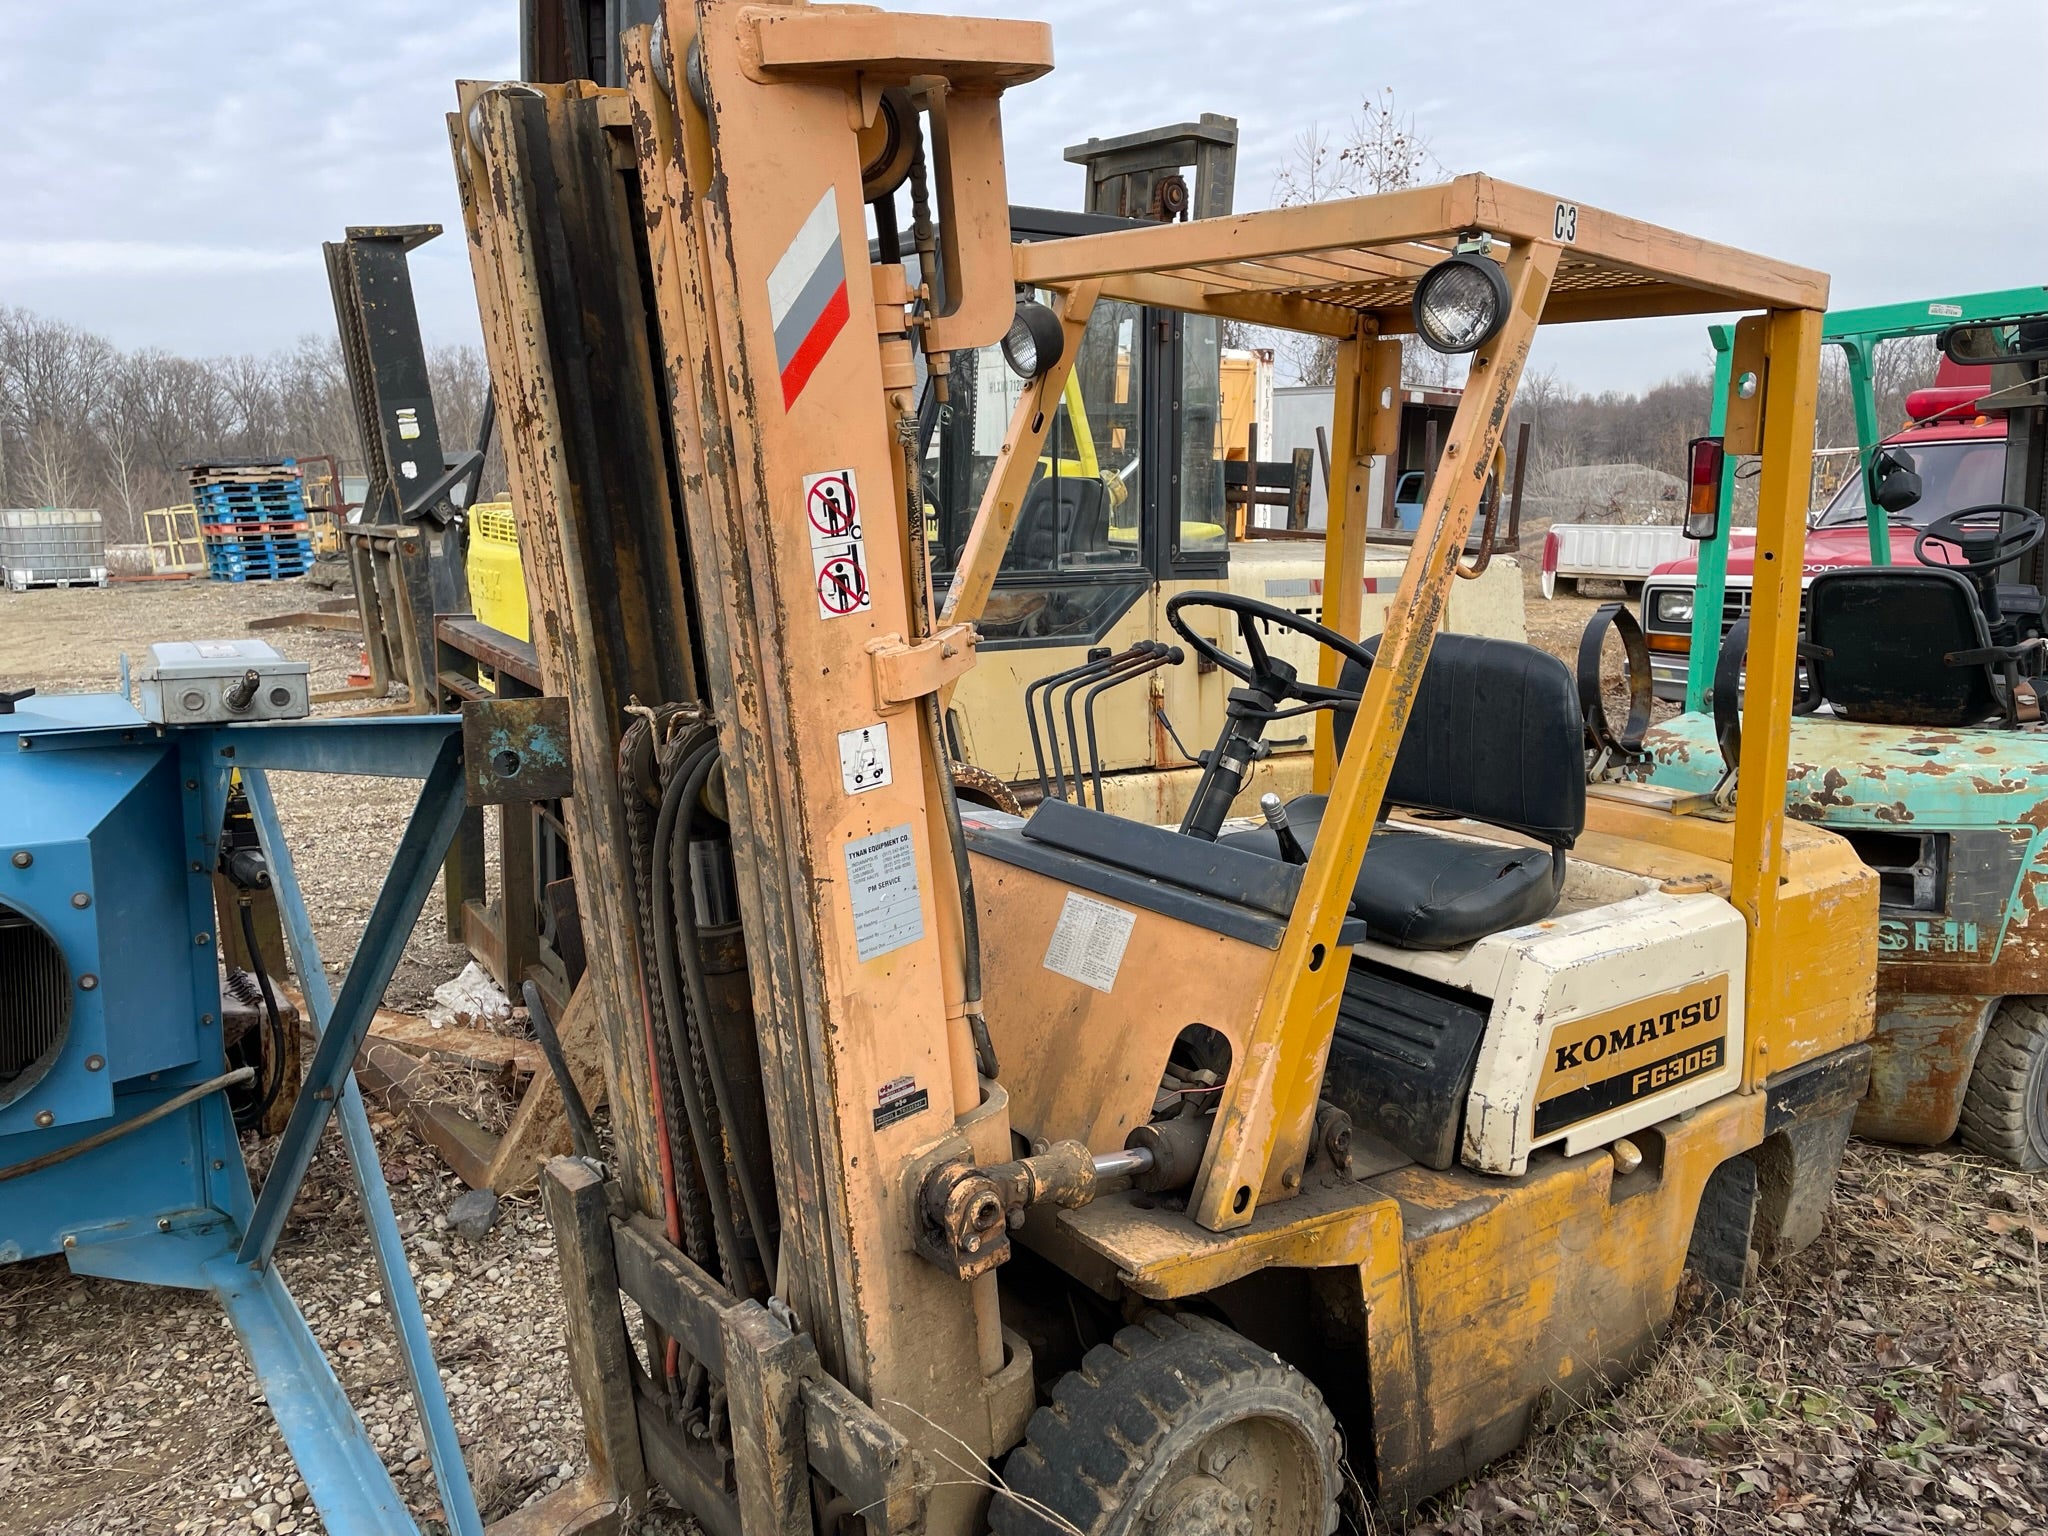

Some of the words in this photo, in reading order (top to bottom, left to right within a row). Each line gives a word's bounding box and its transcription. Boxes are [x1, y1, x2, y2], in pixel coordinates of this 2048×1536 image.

[1555, 204, 1576, 241] C3
[848, 848, 868, 860] TYNAN
[868, 838, 899, 853] EQUIPMENT
[867, 884, 878, 893] PM
[878, 875, 901, 890] SERVICE
[1879, 920, 1978, 953] SHI
[1554, 994, 1722, 1074] KOMATSU
